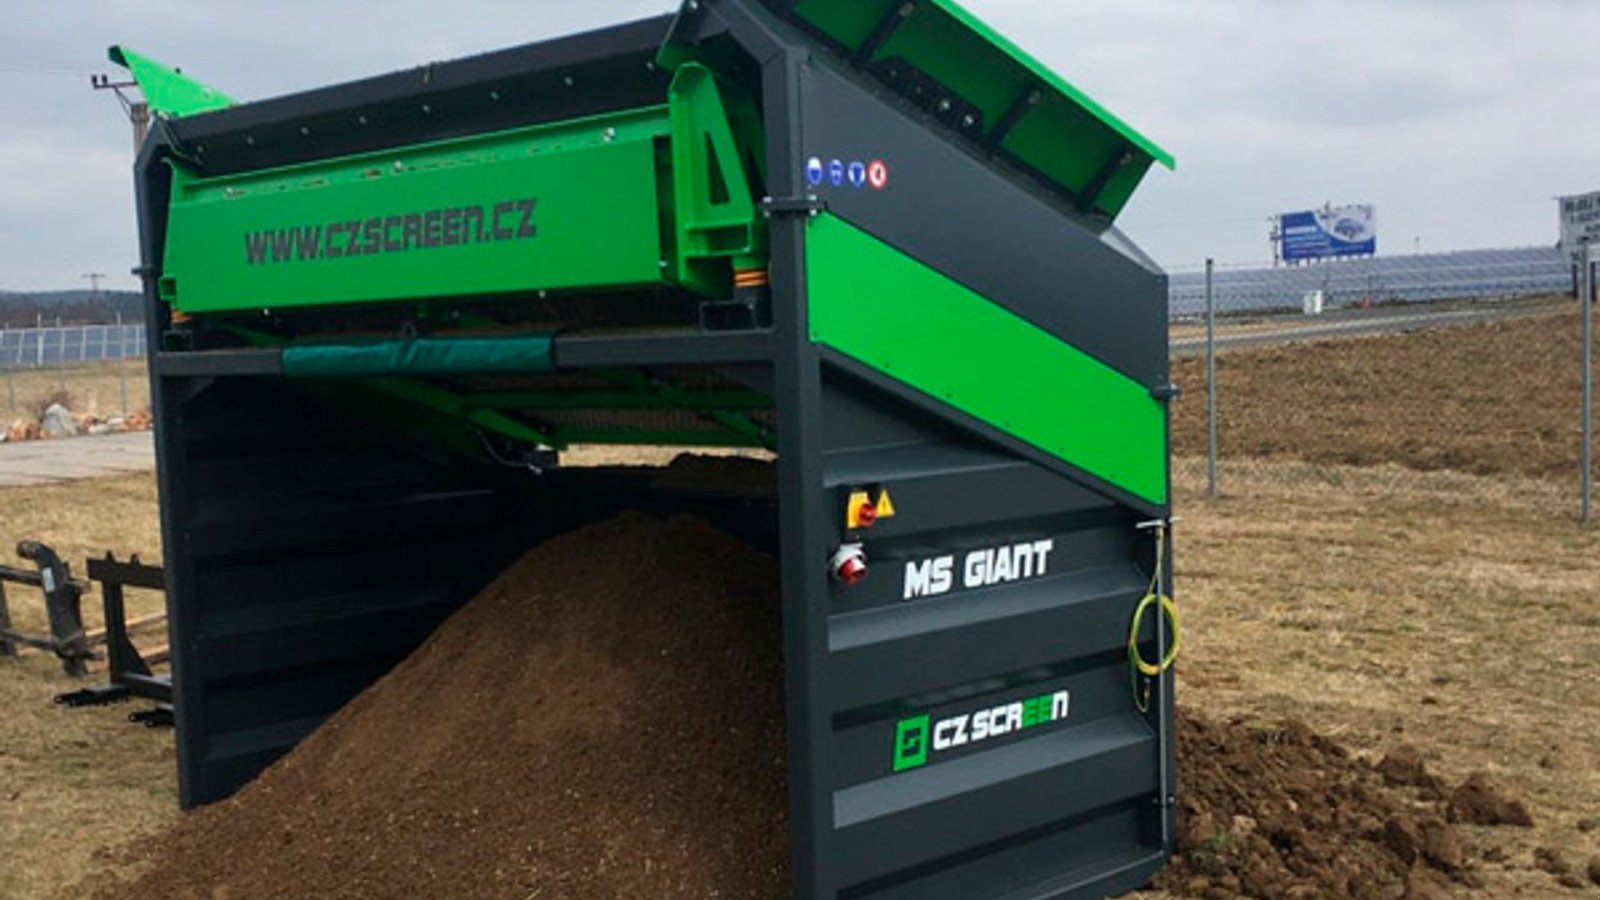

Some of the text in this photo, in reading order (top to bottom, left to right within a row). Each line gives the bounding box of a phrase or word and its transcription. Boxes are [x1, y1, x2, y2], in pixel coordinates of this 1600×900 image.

[245, 198, 537, 263] WWW.CZSCREEN.CZ
[904, 539, 1053, 599] MS GIANT
